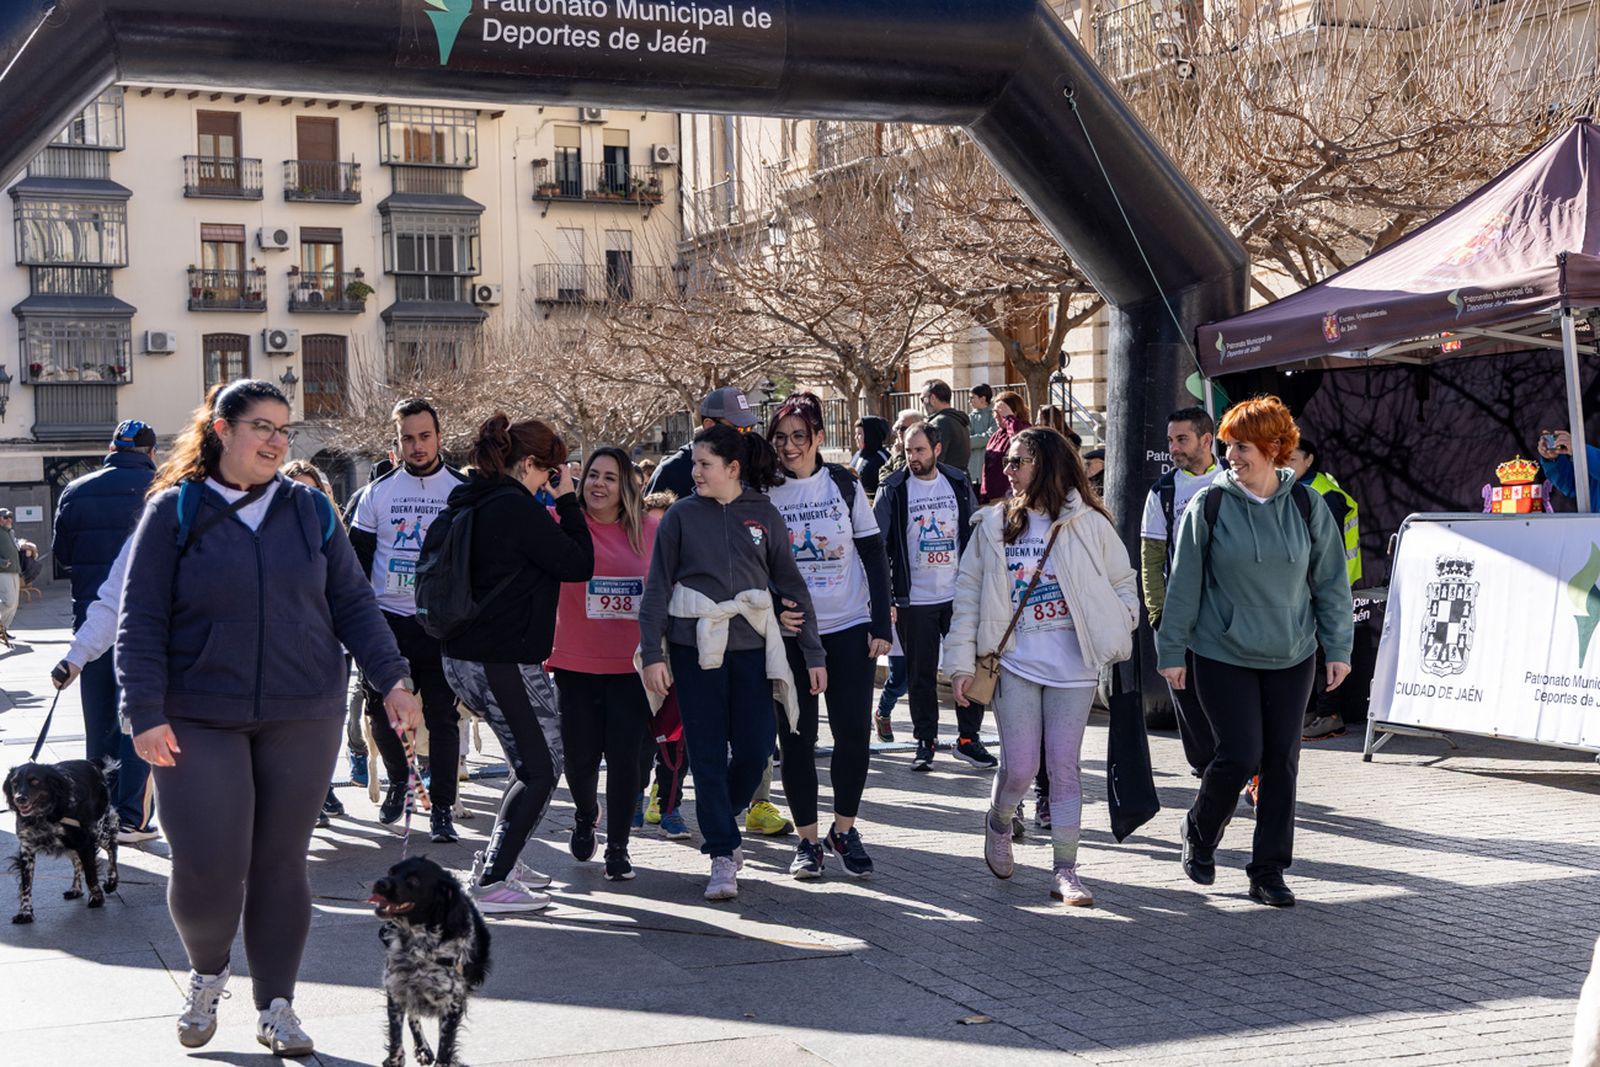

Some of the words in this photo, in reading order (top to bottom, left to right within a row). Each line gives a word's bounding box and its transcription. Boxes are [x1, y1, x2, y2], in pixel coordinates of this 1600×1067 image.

[616, 0, 734, 30] Municipal
[741, 6, 773, 30] de
[482, 18, 601, 49] Deportes
[608, 26, 641, 50] de
[647, 29, 707, 55] Jaén
[1493, 286, 1524, 300] Municipal
[1524, 285, 1534, 295] de
[390, 505, 413, 514] BUENA
[783, 513, 798, 522] ENA
[798, 509, 828, 521] MUERTE
[927, 551, 951, 564] 805
[1004, 546, 1031, 557] BUENA
[600, 595, 632, 611] 938
[1033, 599, 1069, 621] 833
[1524, 671, 1571, 688] Patronato
[1395, 681, 1436, 698] CIUDAD
[1438, 685, 1454, 699] DE
[1454, 685, 1484, 703] JAÉN
[1534, 688, 1578, 706] Deportes
[1579, 692, 1594, 707] de
